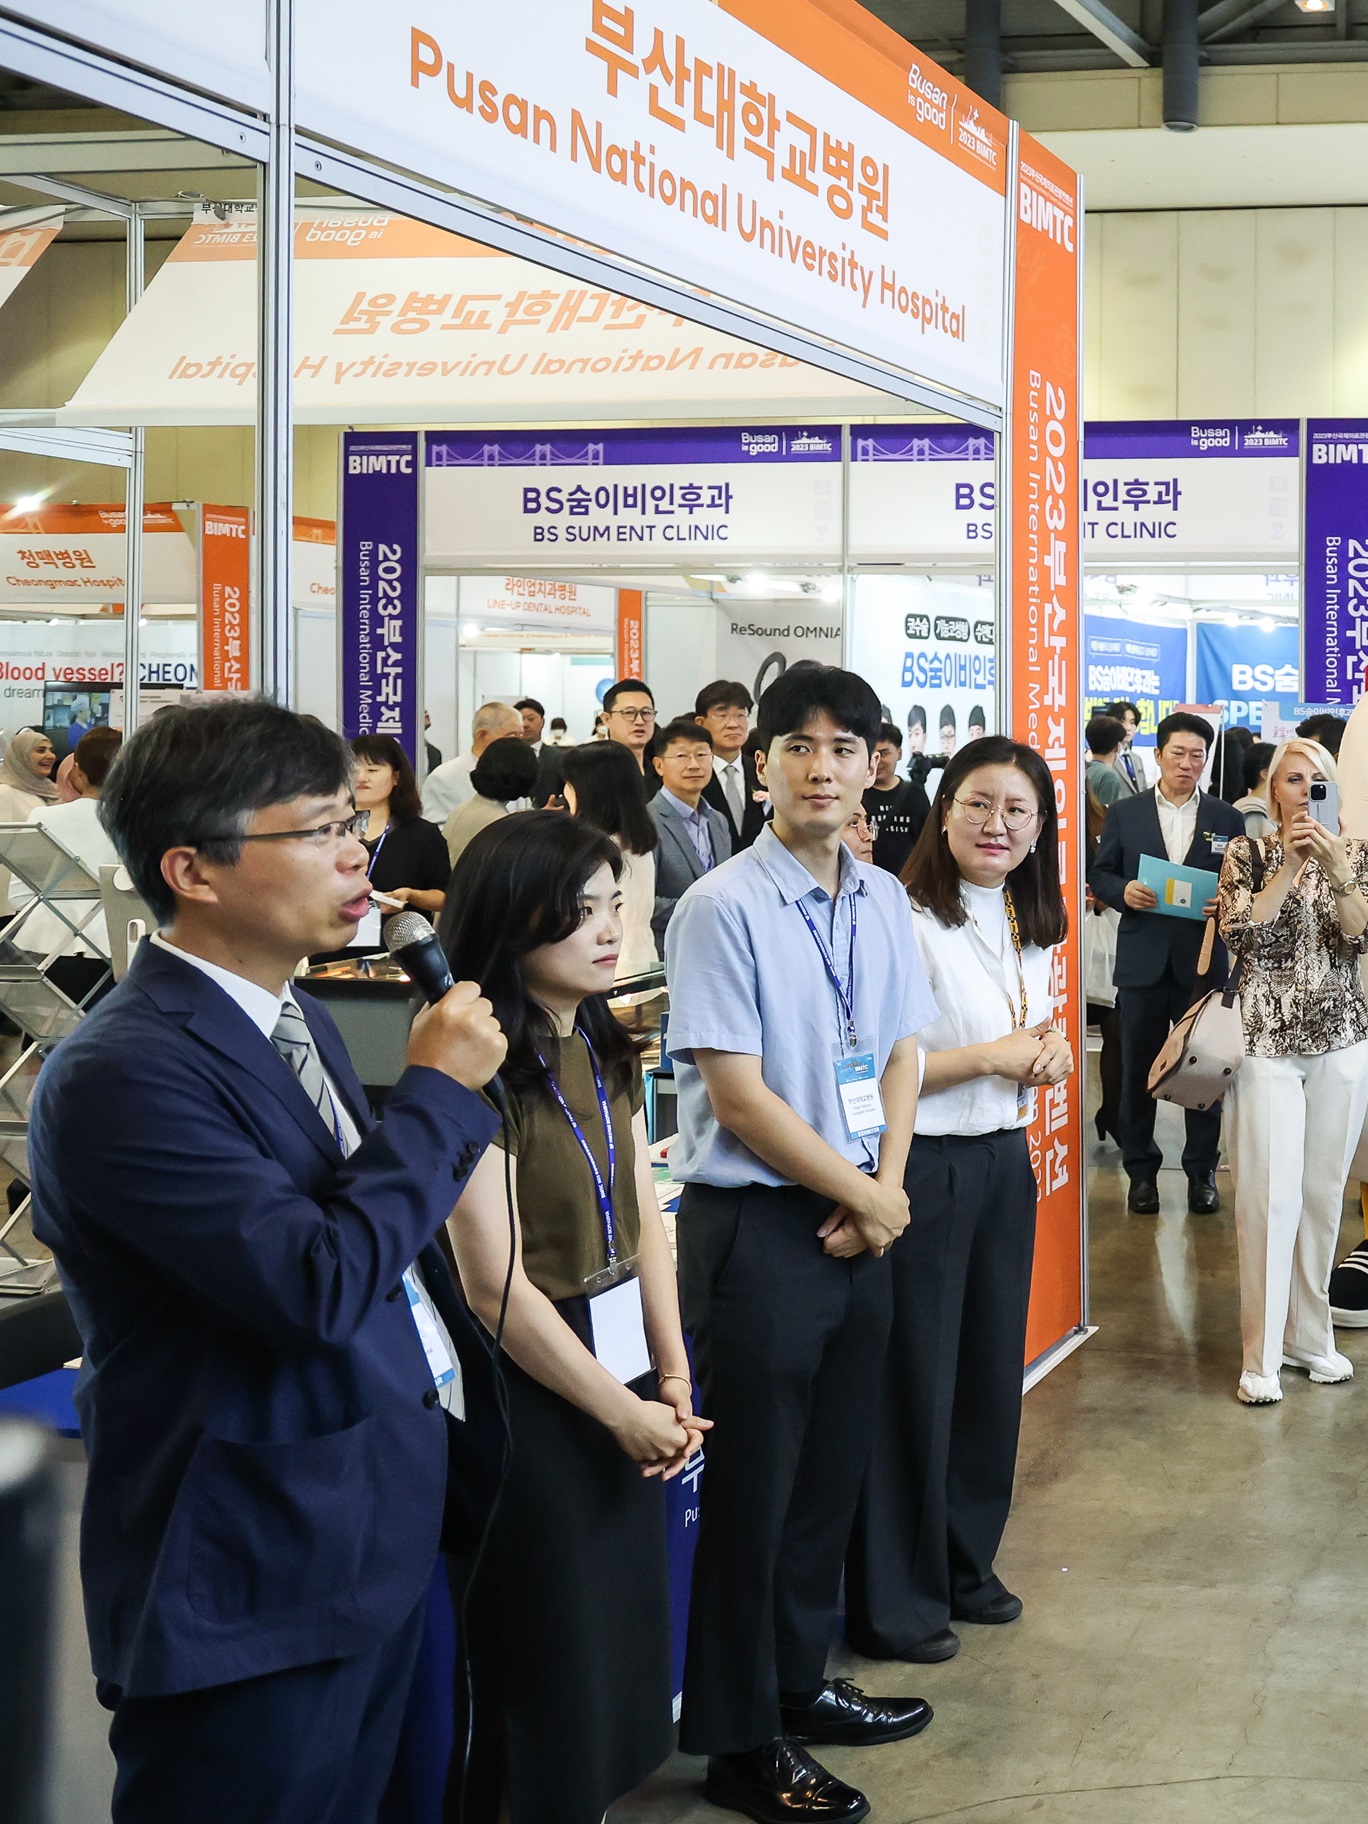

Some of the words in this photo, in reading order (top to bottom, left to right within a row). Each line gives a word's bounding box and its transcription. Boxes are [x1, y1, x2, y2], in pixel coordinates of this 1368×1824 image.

[908, 62, 949, 111] Busan
[585, 0, 890, 242] 부산대학교병원
[907, 89, 916, 107] is
[915, 97, 947, 131] good
[958, 127, 976, 153] 2023
[975, 140, 998, 166] BIMTC
[410, 26, 557, 153] Pusan
[570, 107, 728, 233] National
[736, 192, 874, 309] University
[880, 264, 966, 343] Hospital
[201, 203, 257, 214] 부대학교
[1019, 182, 1075, 254] BIMTC
[1028, 369, 1042, 462] Busan
[742, 432, 779, 444] Busan
[1190, 426, 1230, 438] Busan
[1243, 437, 1264, 446] 2023
[1264, 437, 1289, 446] BIMTC
[749, 443, 779, 456] good
[790, 443, 808, 451] 2023
[1190, 438, 1199, 446] is
[1199, 437, 1231, 451] good
[348, 455, 412, 474] BIMTC
[522, 482, 733, 516] BS숨이비인후과
[205, 521, 246, 539] BIMTC
[533, 525, 559, 542] BS
[565, 525, 611, 542] SUM
[616, 525, 657, 542] ENT
[662, 524, 729, 541] CLINIC
[966, 522, 993, 540] BS
[1105, 521, 1178, 539] CLINIC
[17, 549, 96, 569] 청맥병원
[359, 541, 374, 586] Busan
[1325, 536, 1342, 585] Busan
[80, 576, 126, 590] Hospit
[1027, 472, 1042, 672] International
[309, 581, 337, 596] Cheo
[505, 577, 577, 602] 라인업치과병원
[359, 590, 374, 687] International
[730, 622, 791, 638] ReSound
[793, 625, 841, 639] OMNIA
[1325, 588, 1342, 693] International
[376, 543, 404, 742] 2023부산국제
[52, 661, 124, 682] vessel?
[901, 651, 995, 690] BS숨이비인
[359, 689, 374, 736] Medic
[684, 1507, 700, 1528] Pu
